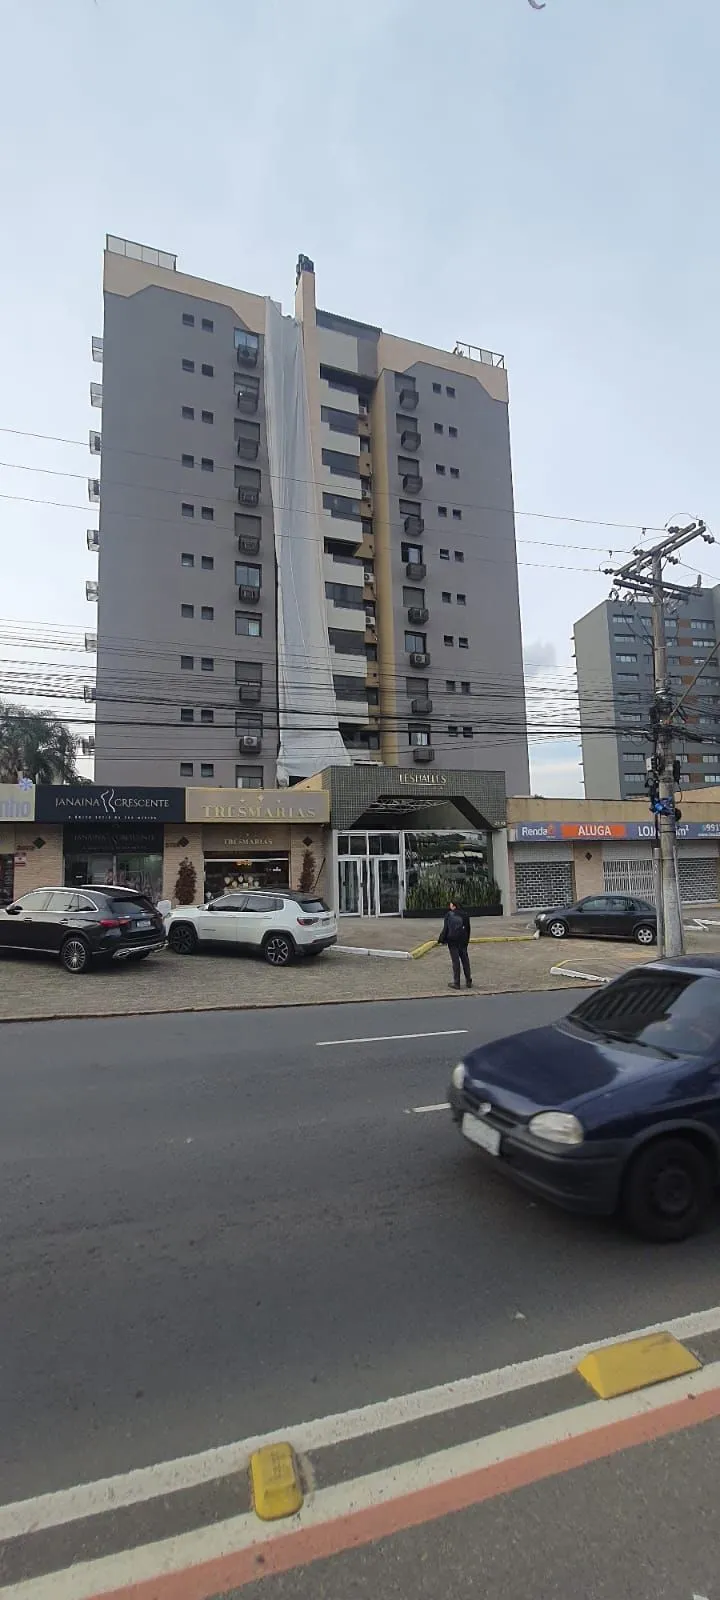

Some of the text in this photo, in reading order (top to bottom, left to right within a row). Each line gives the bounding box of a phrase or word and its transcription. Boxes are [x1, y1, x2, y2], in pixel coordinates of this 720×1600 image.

[55, 797, 170, 808] JANAINA CRESCENTE
[521, 827, 548, 836] Renda
[578, 825, 612, 836] ALUGA
